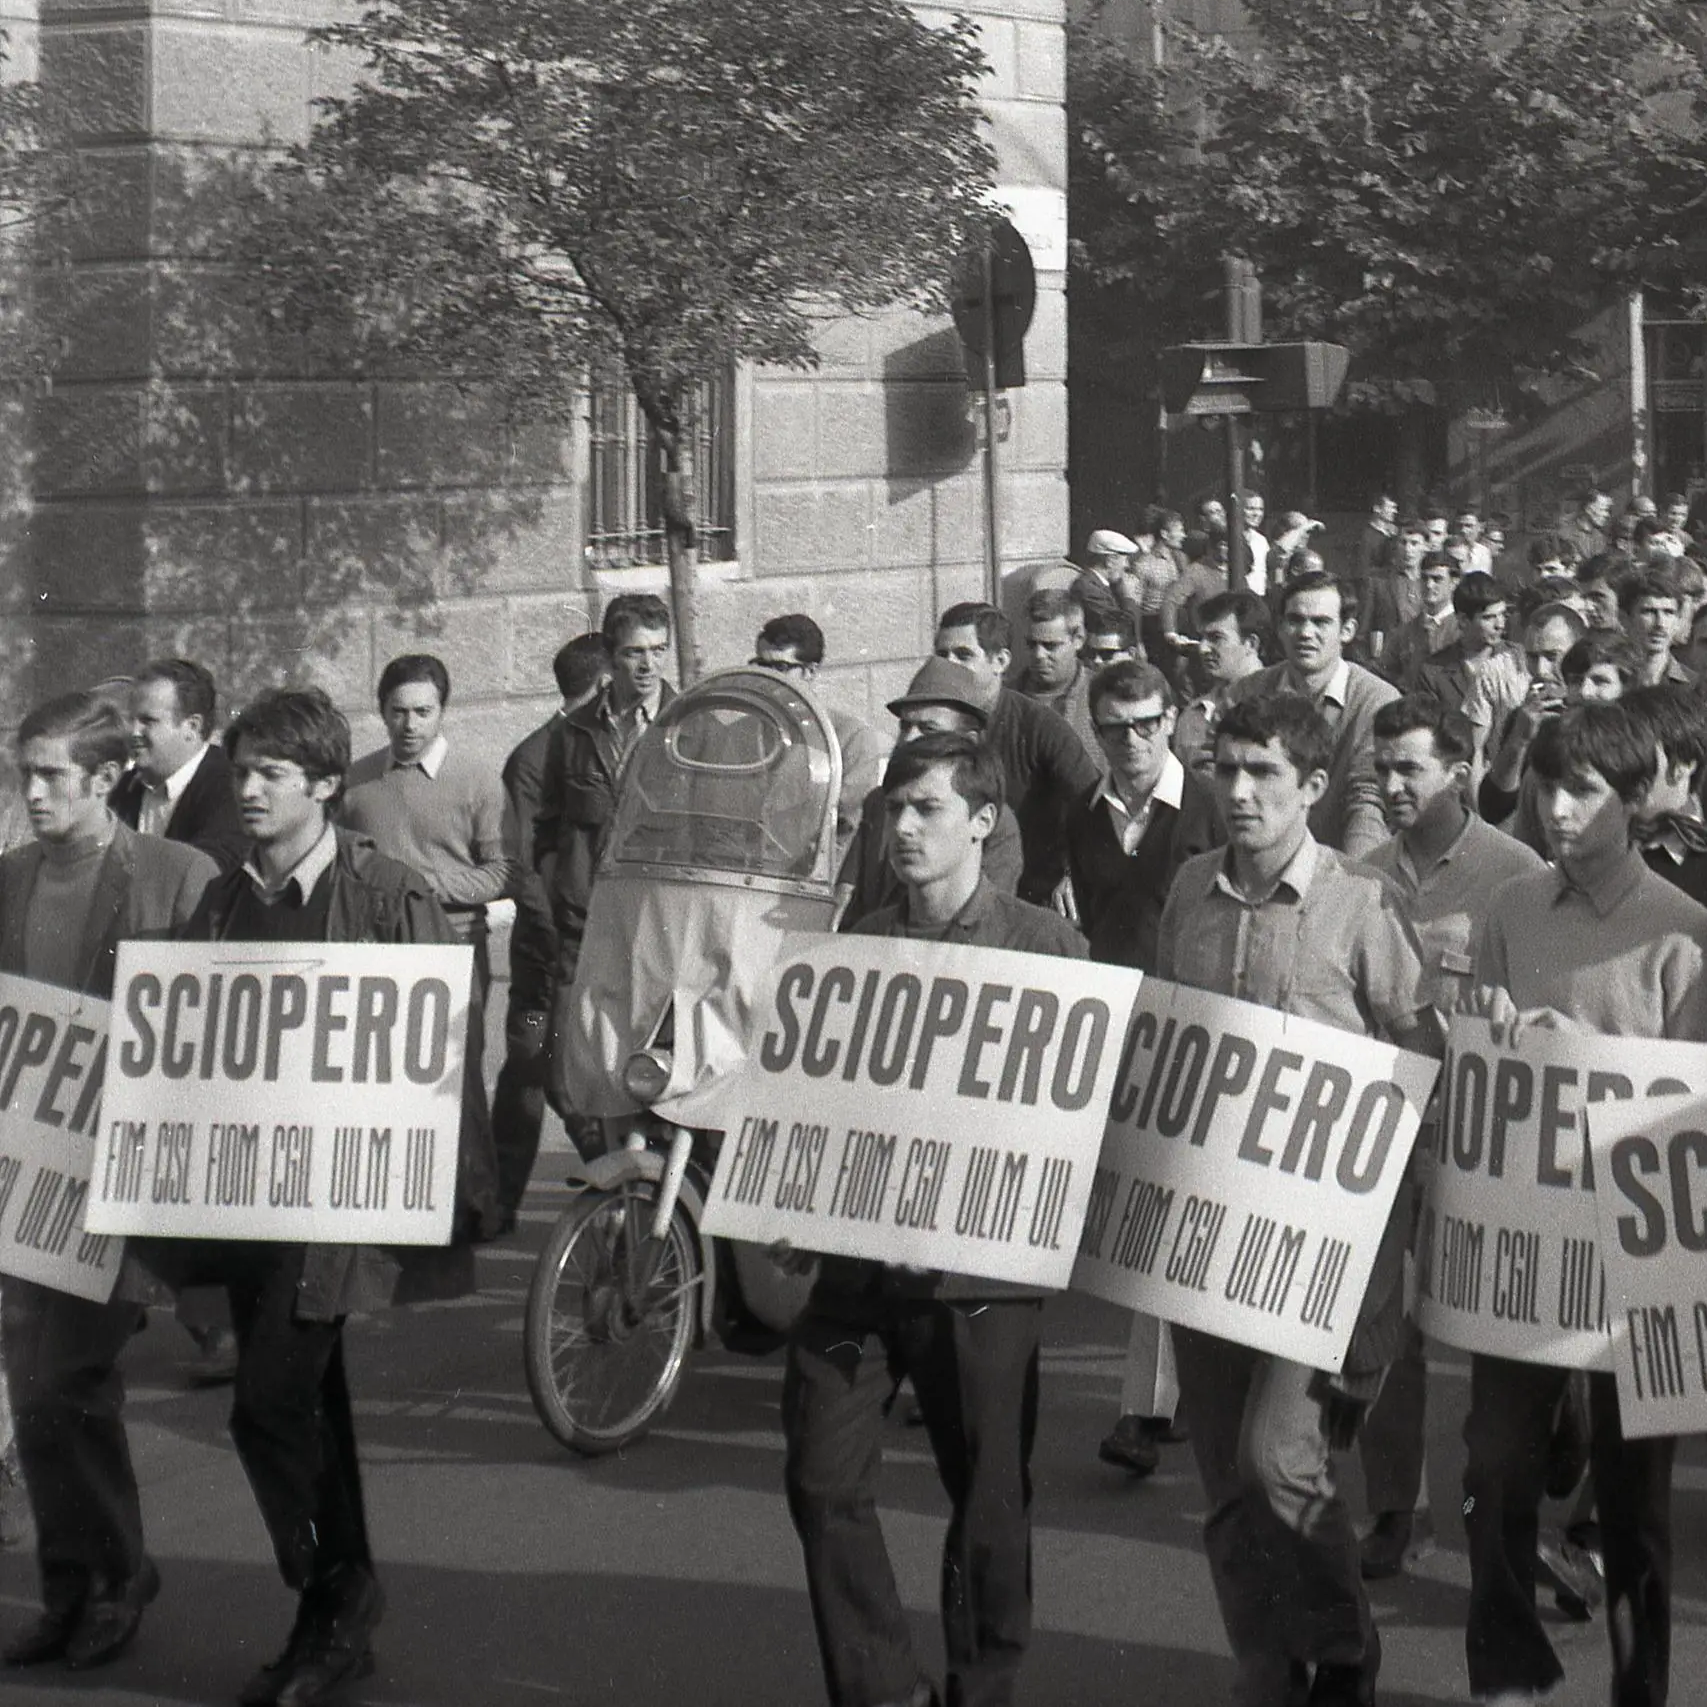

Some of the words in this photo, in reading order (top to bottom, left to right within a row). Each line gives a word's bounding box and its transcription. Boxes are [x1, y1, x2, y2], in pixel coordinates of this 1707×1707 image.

[119, 972, 451, 1085] SCIOPERO
[760, 963, 1110, 1111] SCIOPERO
[1110, 1011, 1406, 1195] CIOPERO
